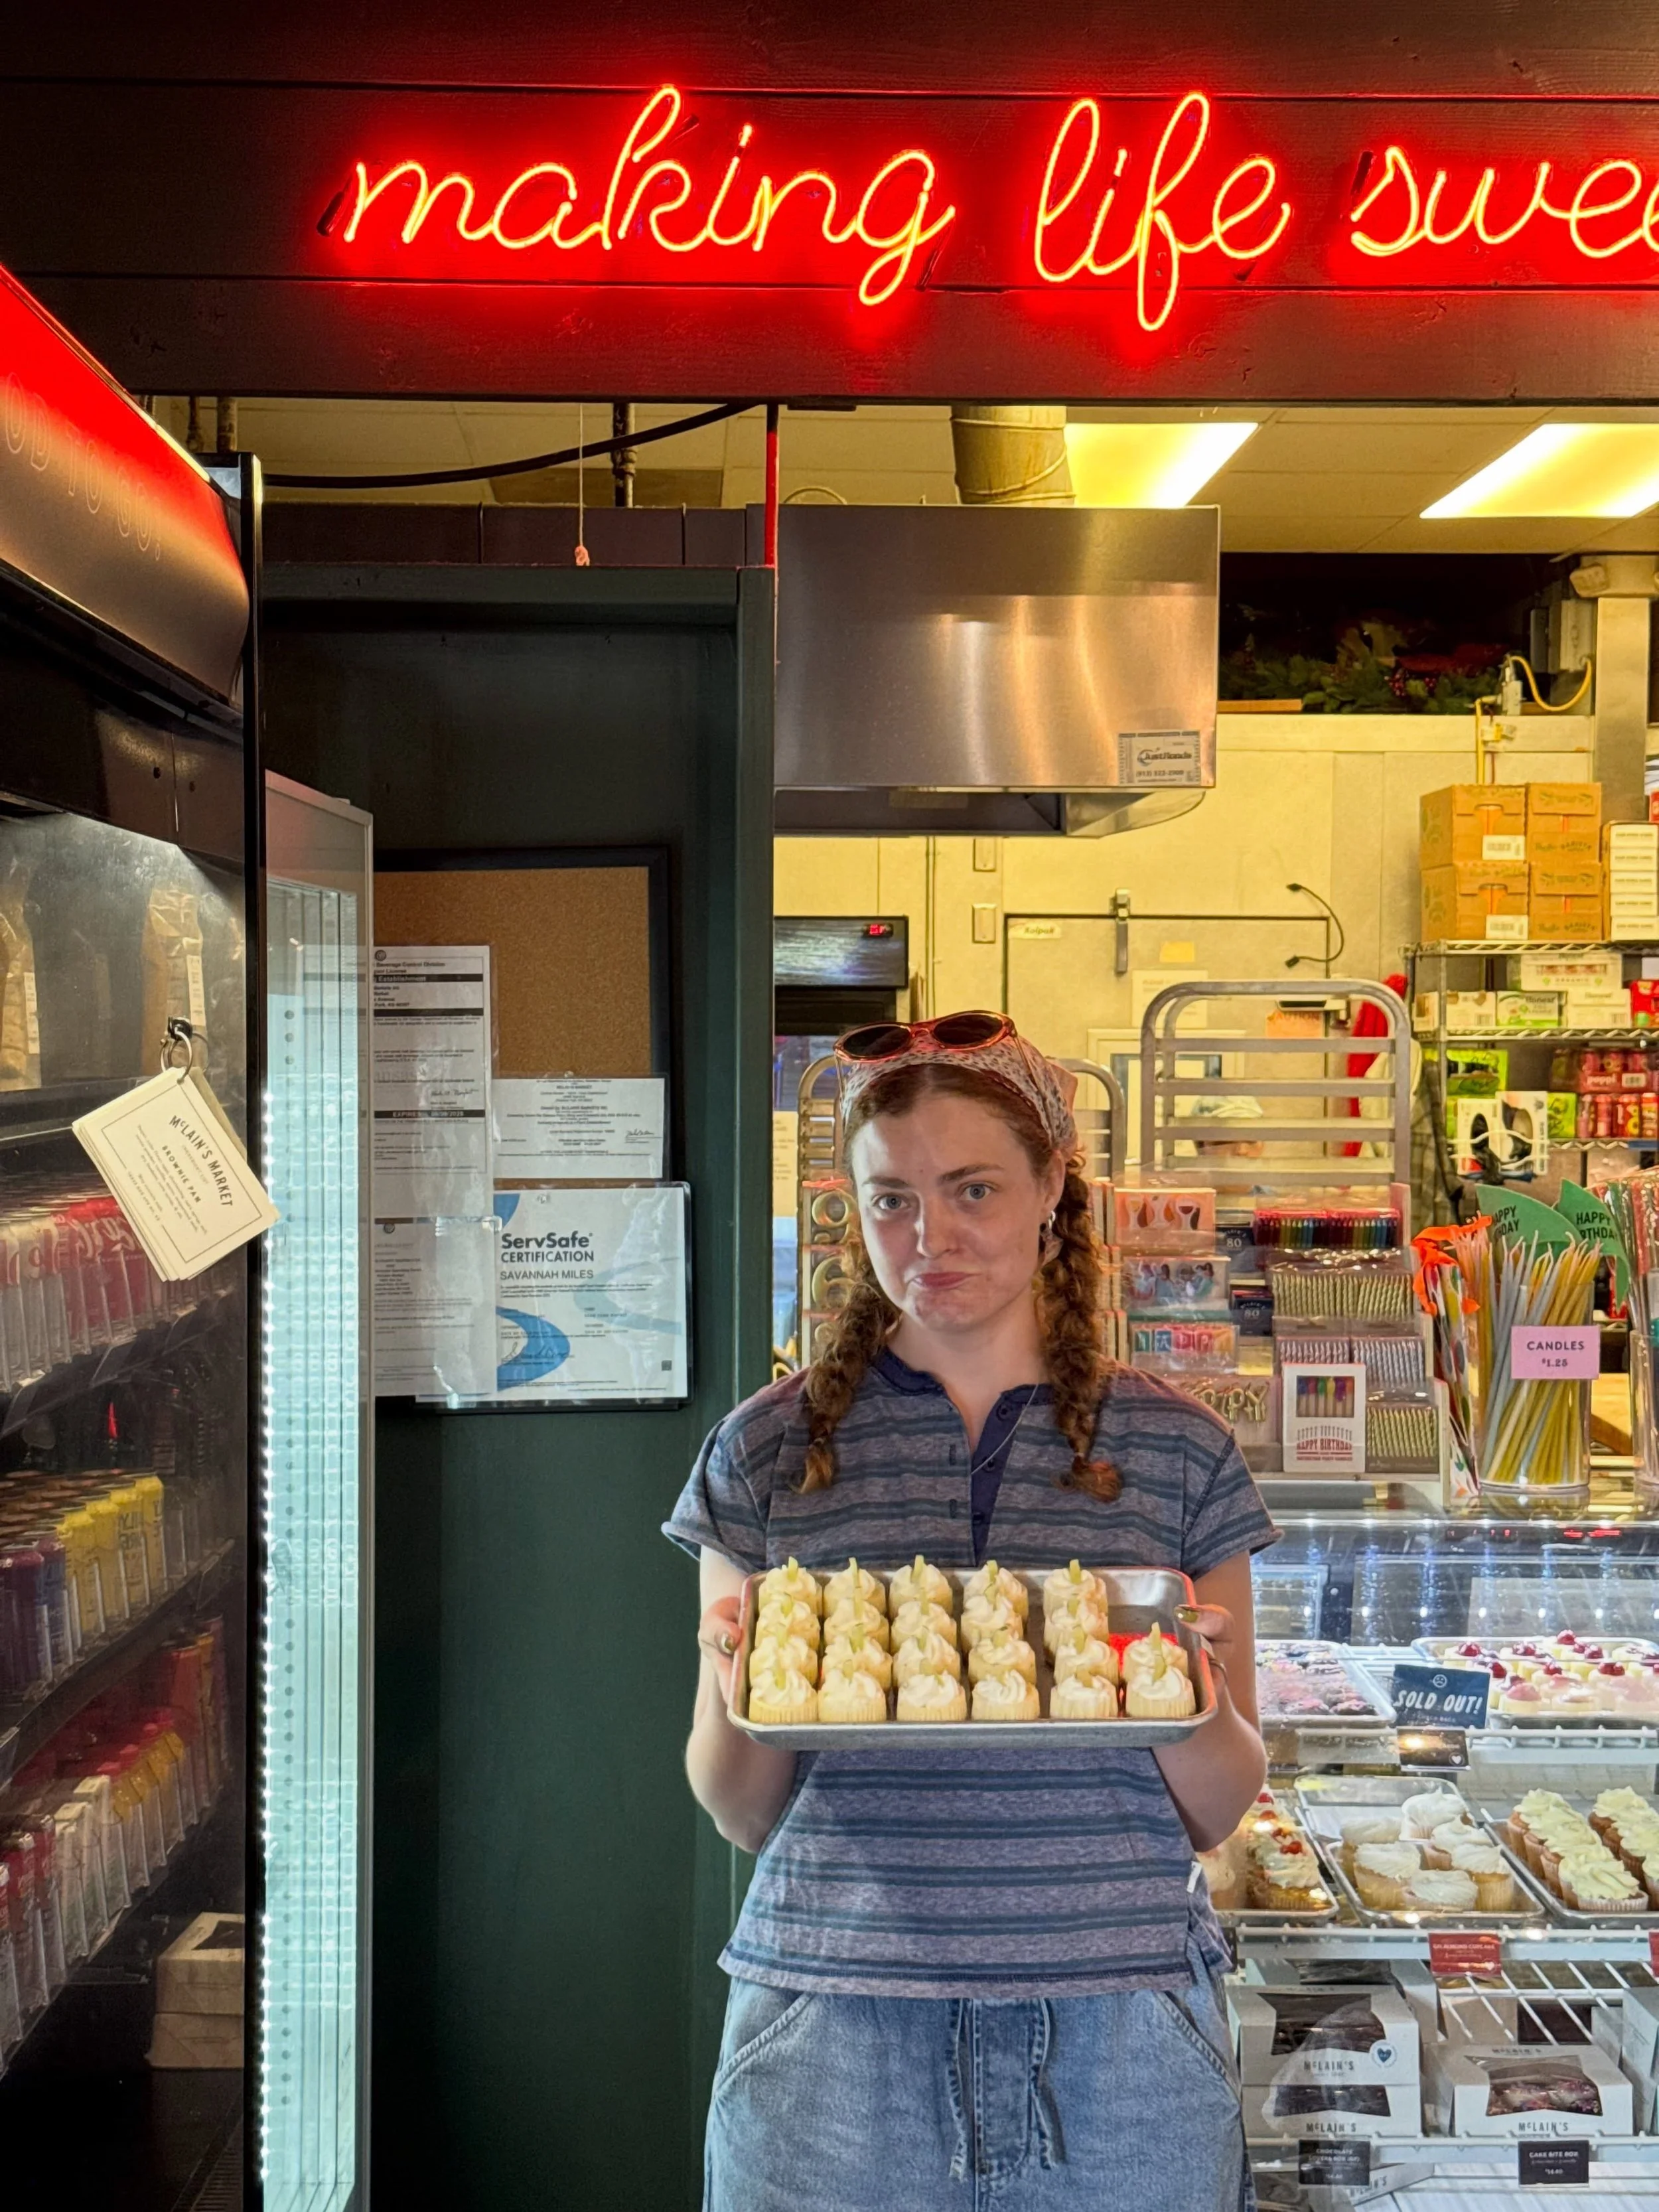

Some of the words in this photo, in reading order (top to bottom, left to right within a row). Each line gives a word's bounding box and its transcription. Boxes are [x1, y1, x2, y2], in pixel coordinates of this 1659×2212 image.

[344, 84, 957, 307] making
[1034, 90, 1293, 332] life
[1350, 145, 1659, 259] swe
[169, 1115, 213, 1160] McLAIN'S
[208, 1159, 233, 1207] MARKET
[161, 1145, 189, 1184] BROWNIE
[187, 1185, 202, 1203] PAN
[1494, 1205, 1517, 1226] APPY
[501, 1230, 590, 1249] ServSafe
[1226, 1237, 1242, 1248] 80
[500, 1250, 595, 1263] CERTIFICATION
[500, 1270, 559, 1280] SAVANNAH
[561, 1269, 594, 1280] MILES
[1526, 1341, 1585, 1351] CANDLES
[1297, 1438, 1318, 1451] HAPPY
[1320, 1438, 1352, 1451] BIRTHDAY
[1393, 1690, 1437, 1710] SOLD
[1443, 1694, 1483, 1715] OUT!
[1303, 2060, 1354, 2071] McLAIN'S
[1306, 2122, 1356, 2132] McLAIN'S
[1518, 2122, 1569, 2132] McLAIN'S
